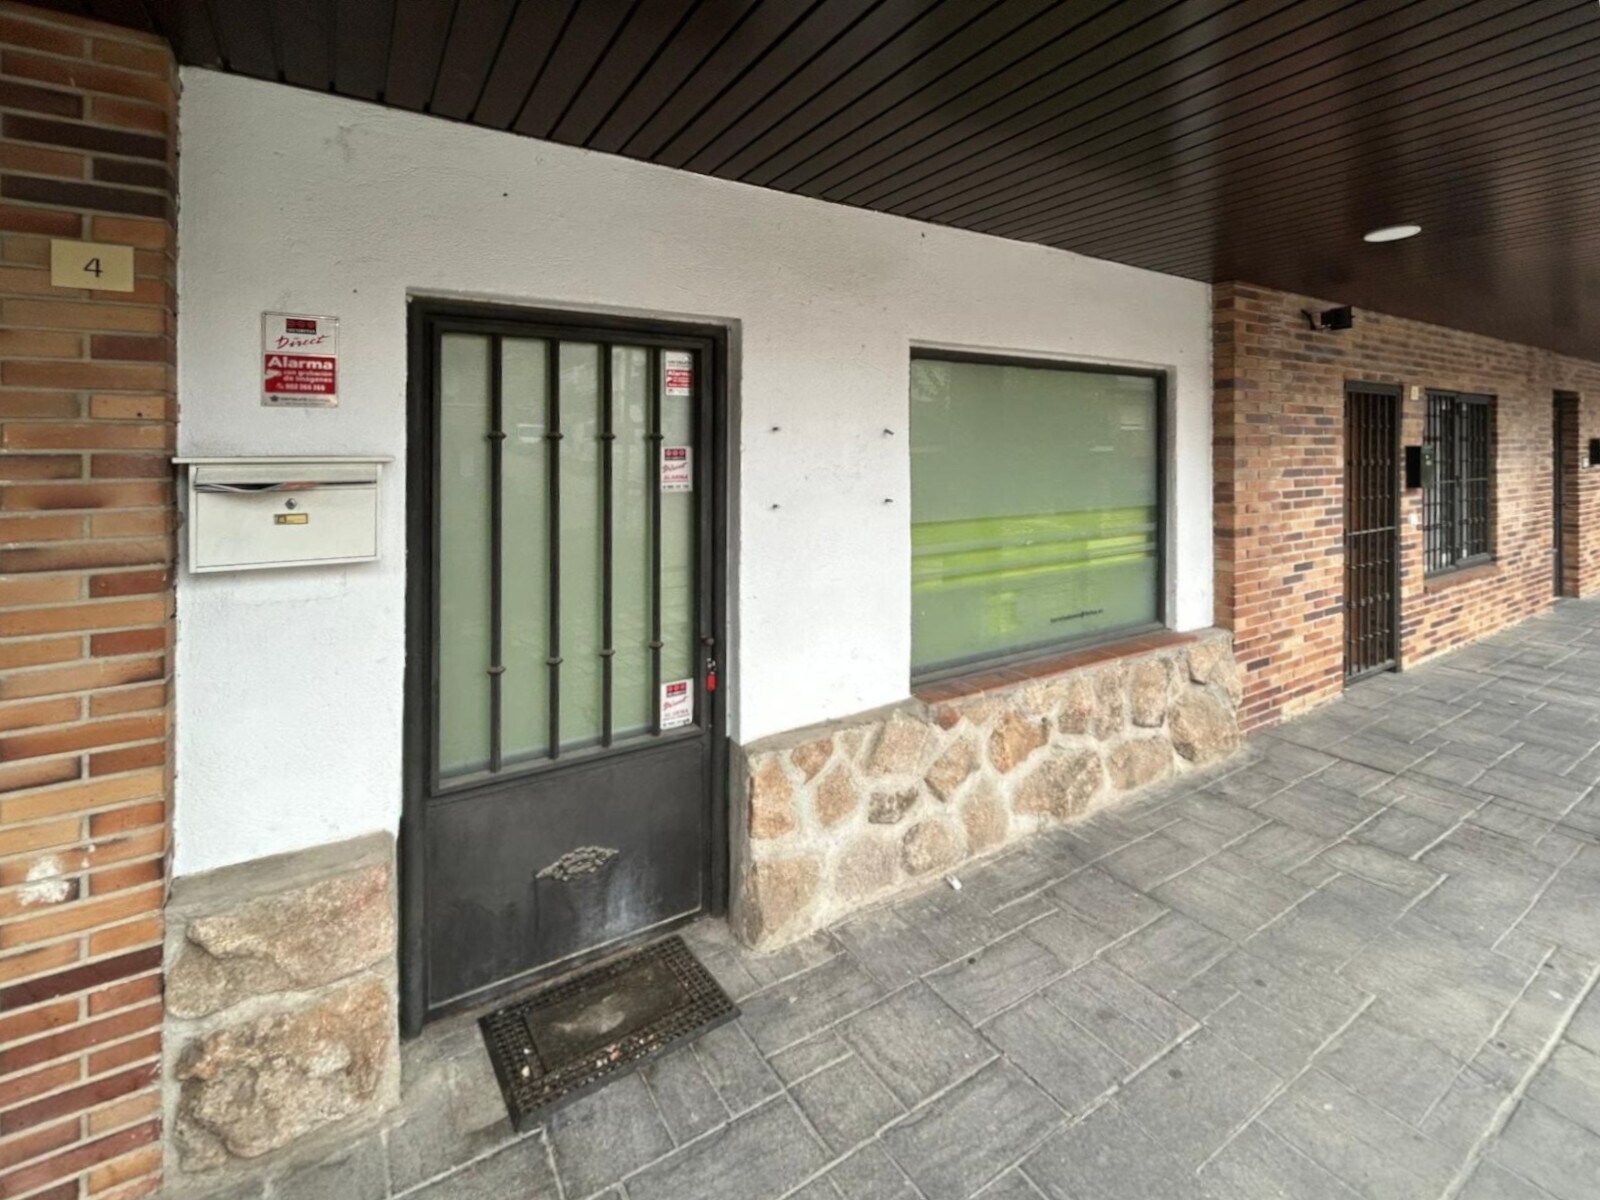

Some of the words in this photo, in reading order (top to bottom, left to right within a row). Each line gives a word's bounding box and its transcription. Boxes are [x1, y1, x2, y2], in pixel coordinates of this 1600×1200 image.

[83, 257, 103, 278] 4
[276, 334, 331, 349] Direct
[267, 356, 333, 370] Alarma
